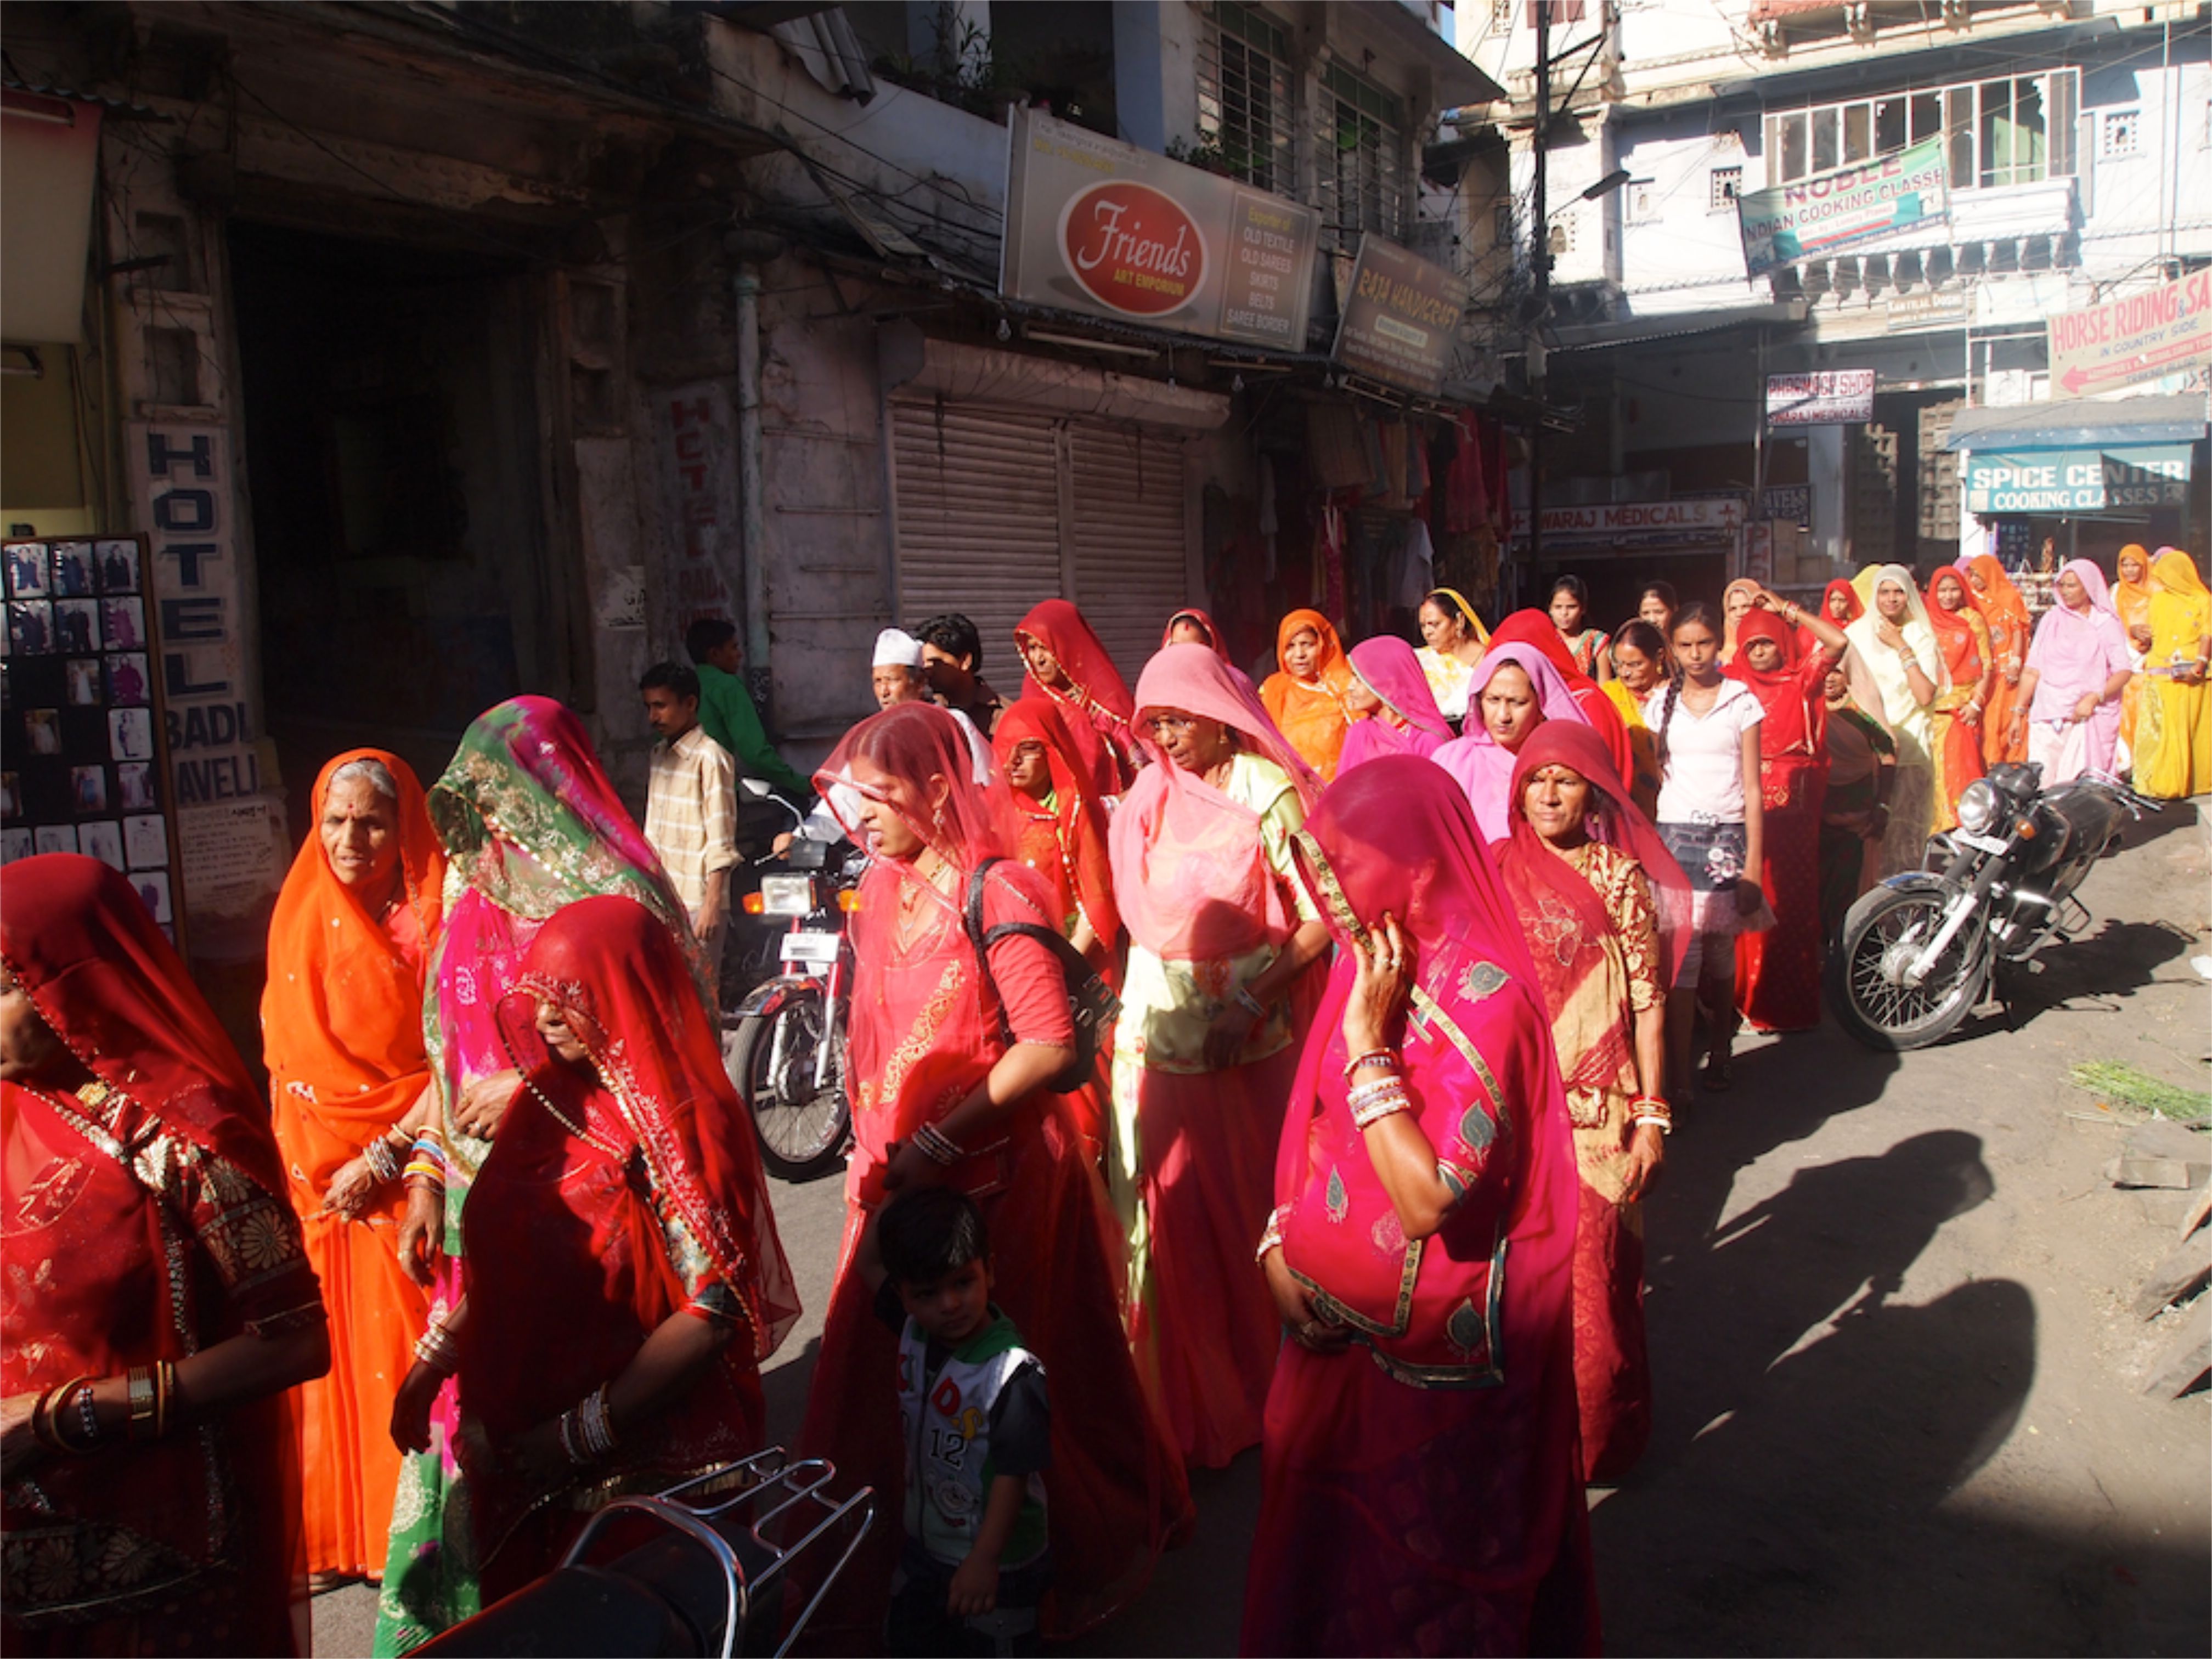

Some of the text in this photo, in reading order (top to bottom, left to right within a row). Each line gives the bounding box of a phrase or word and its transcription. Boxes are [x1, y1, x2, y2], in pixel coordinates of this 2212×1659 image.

[1784, 156, 1901, 207] NOBLE
[1799, 189, 1874, 223] COOKING
[1077, 199, 1191, 276] Friends
[1244, 226, 1295, 253] OLD TEXTILE
[1241, 247, 1260, 266] OLD
[1113, 268, 1184, 297] ART EMPORIUM
[1249, 271, 1279, 291] SKIRTS
[1248, 291, 1276, 310] BELTS
[2051, 306, 2111, 354] HORSE
[2114, 283, 2178, 339] RIDING
[2185, 271, 2211, 315] SA
[1257, 313, 1290, 334] BORDER
[2100, 346, 2111, 358] IN
[2113, 329, 2166, 354] COUNTRY
[2171, 317, 2199, 337] SIDE
[1768, 373, 1872, 397] PHARMACY SHOP
[1810, 407, 1871, 423] MEDICALS
[1972, 460, 2185, 489] SPICE CENTER
[1994, 484, 2159, 511] COOKING CLASSES
[1540, 505, 1707, 529] WARAJ MEDICALS
[148, 433, 229, 696] HOTEL
[165, 702, 247, 750] BADI
[179, 754, 258, 805] AVELI
[930, 1428, 964, 1467] 12
